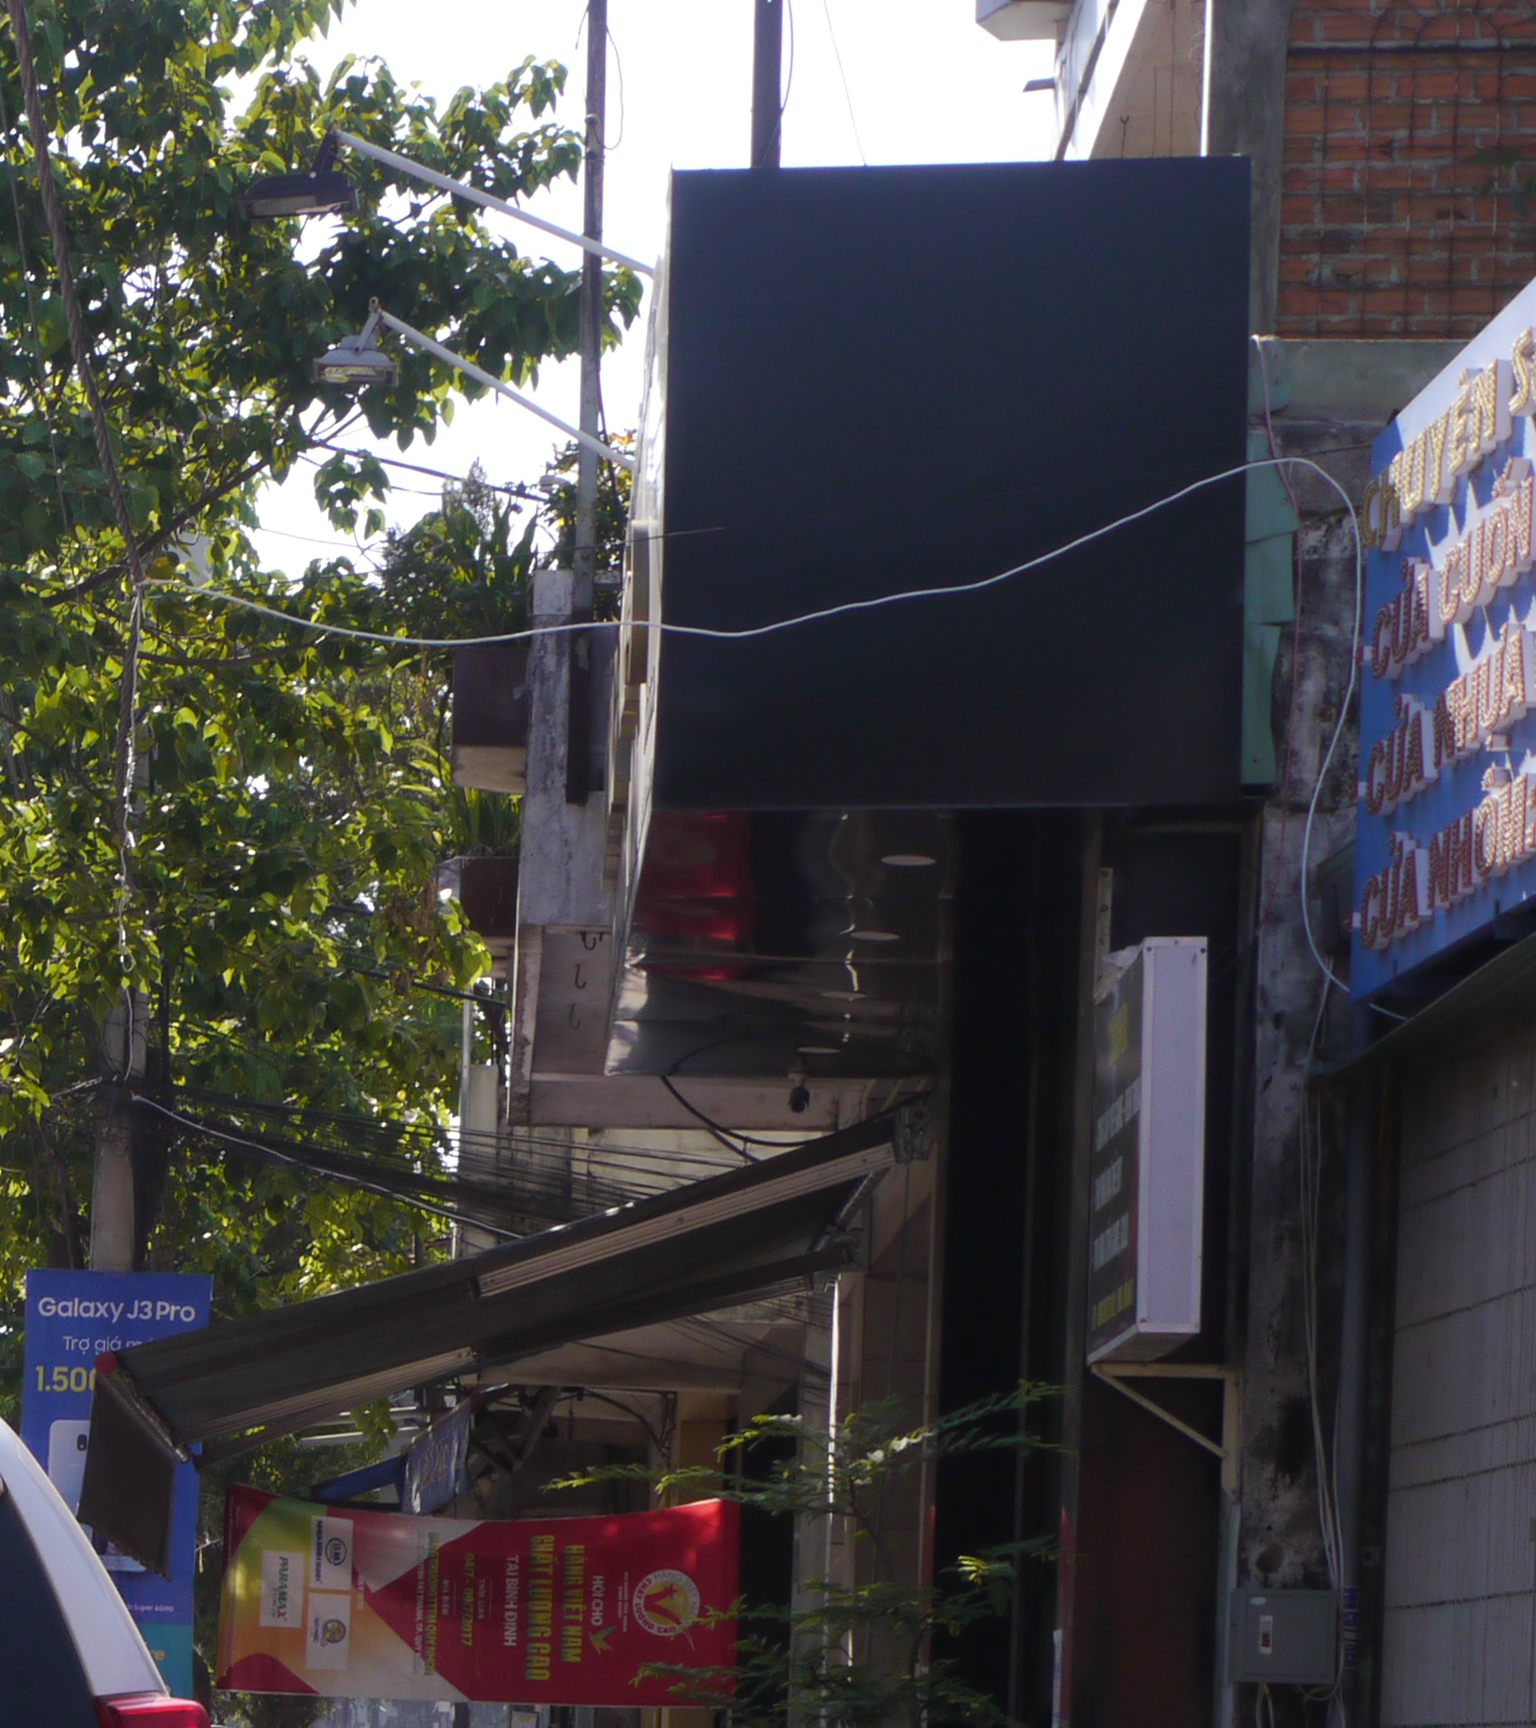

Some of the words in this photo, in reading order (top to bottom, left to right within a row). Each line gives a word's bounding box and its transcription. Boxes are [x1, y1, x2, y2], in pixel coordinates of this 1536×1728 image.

[1366, 693, 1425, 815] CỬA
[1360, 831, 1419, 949] CỬA
[37, 1296, 124, 1325] Galaxy
[127, 1300, 153, 1321] J3
[155, 1300, 196, 1323] Pro
[62, 1335, 90, 1356] Trợ
[94, 1334, 122, 1354] giá
[528, 1534, 558, 1574] CHẤT
[563, 1544, 587, 1585] HÀNG
[278, 1556, 289, 1620] PARAMAX
[561, 1588, 586, 1622] VIỆT
[525, 1579, 554, 1637] LƯỢNG
[502, 1610, 518, 1647] ĐỊNH
[560, 1625, 583, 1662] NAM
[524, 1643, 552, 1681] CAO
